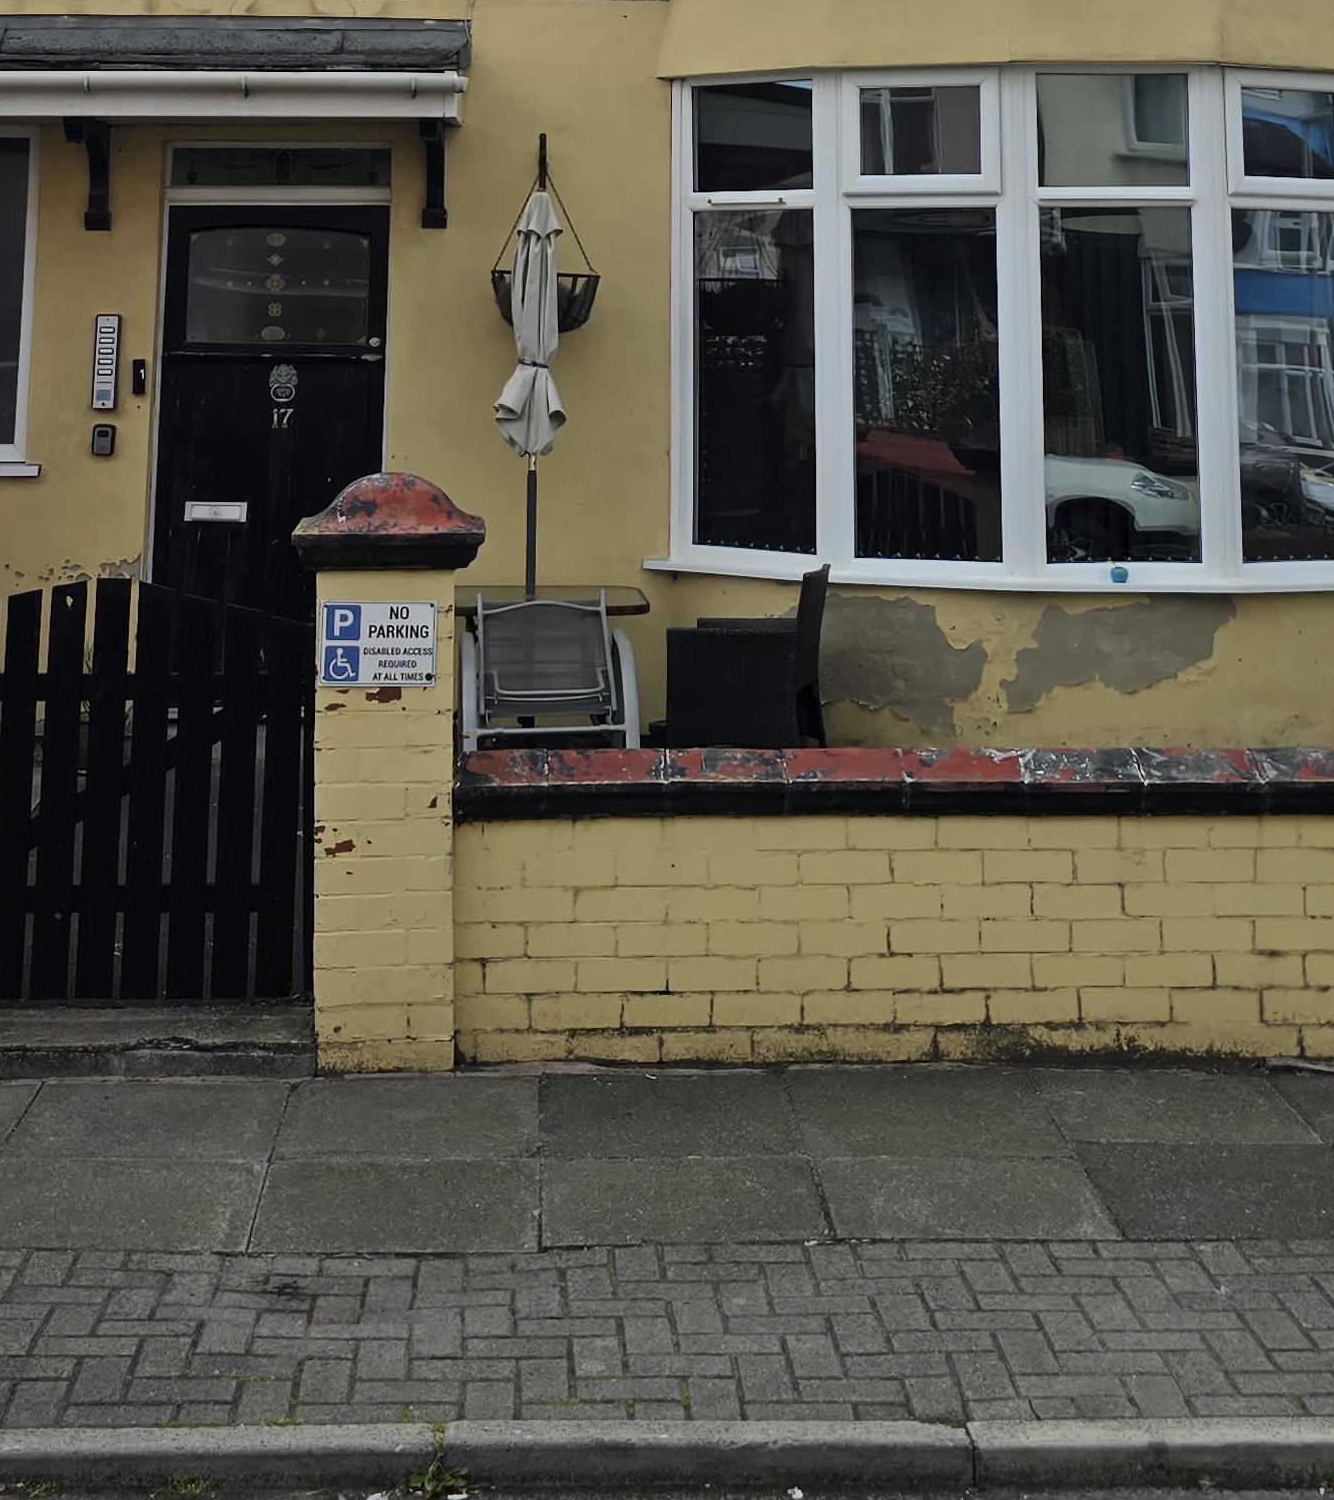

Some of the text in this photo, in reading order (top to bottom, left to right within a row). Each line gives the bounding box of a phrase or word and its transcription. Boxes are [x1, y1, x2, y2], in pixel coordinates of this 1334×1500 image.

[271, 408, 295, 429] 17
[389, 606, 409, 619] NO
[334, 609, 353, 636] P
[368, 625, 429, 638] PARKING
[363, 648, 401, 656] DISABLED
[378, 660, 417, 668] REQUIRED
[383, 673, 397, 681] ALL
[401, 673, 423, 681] TIMES
